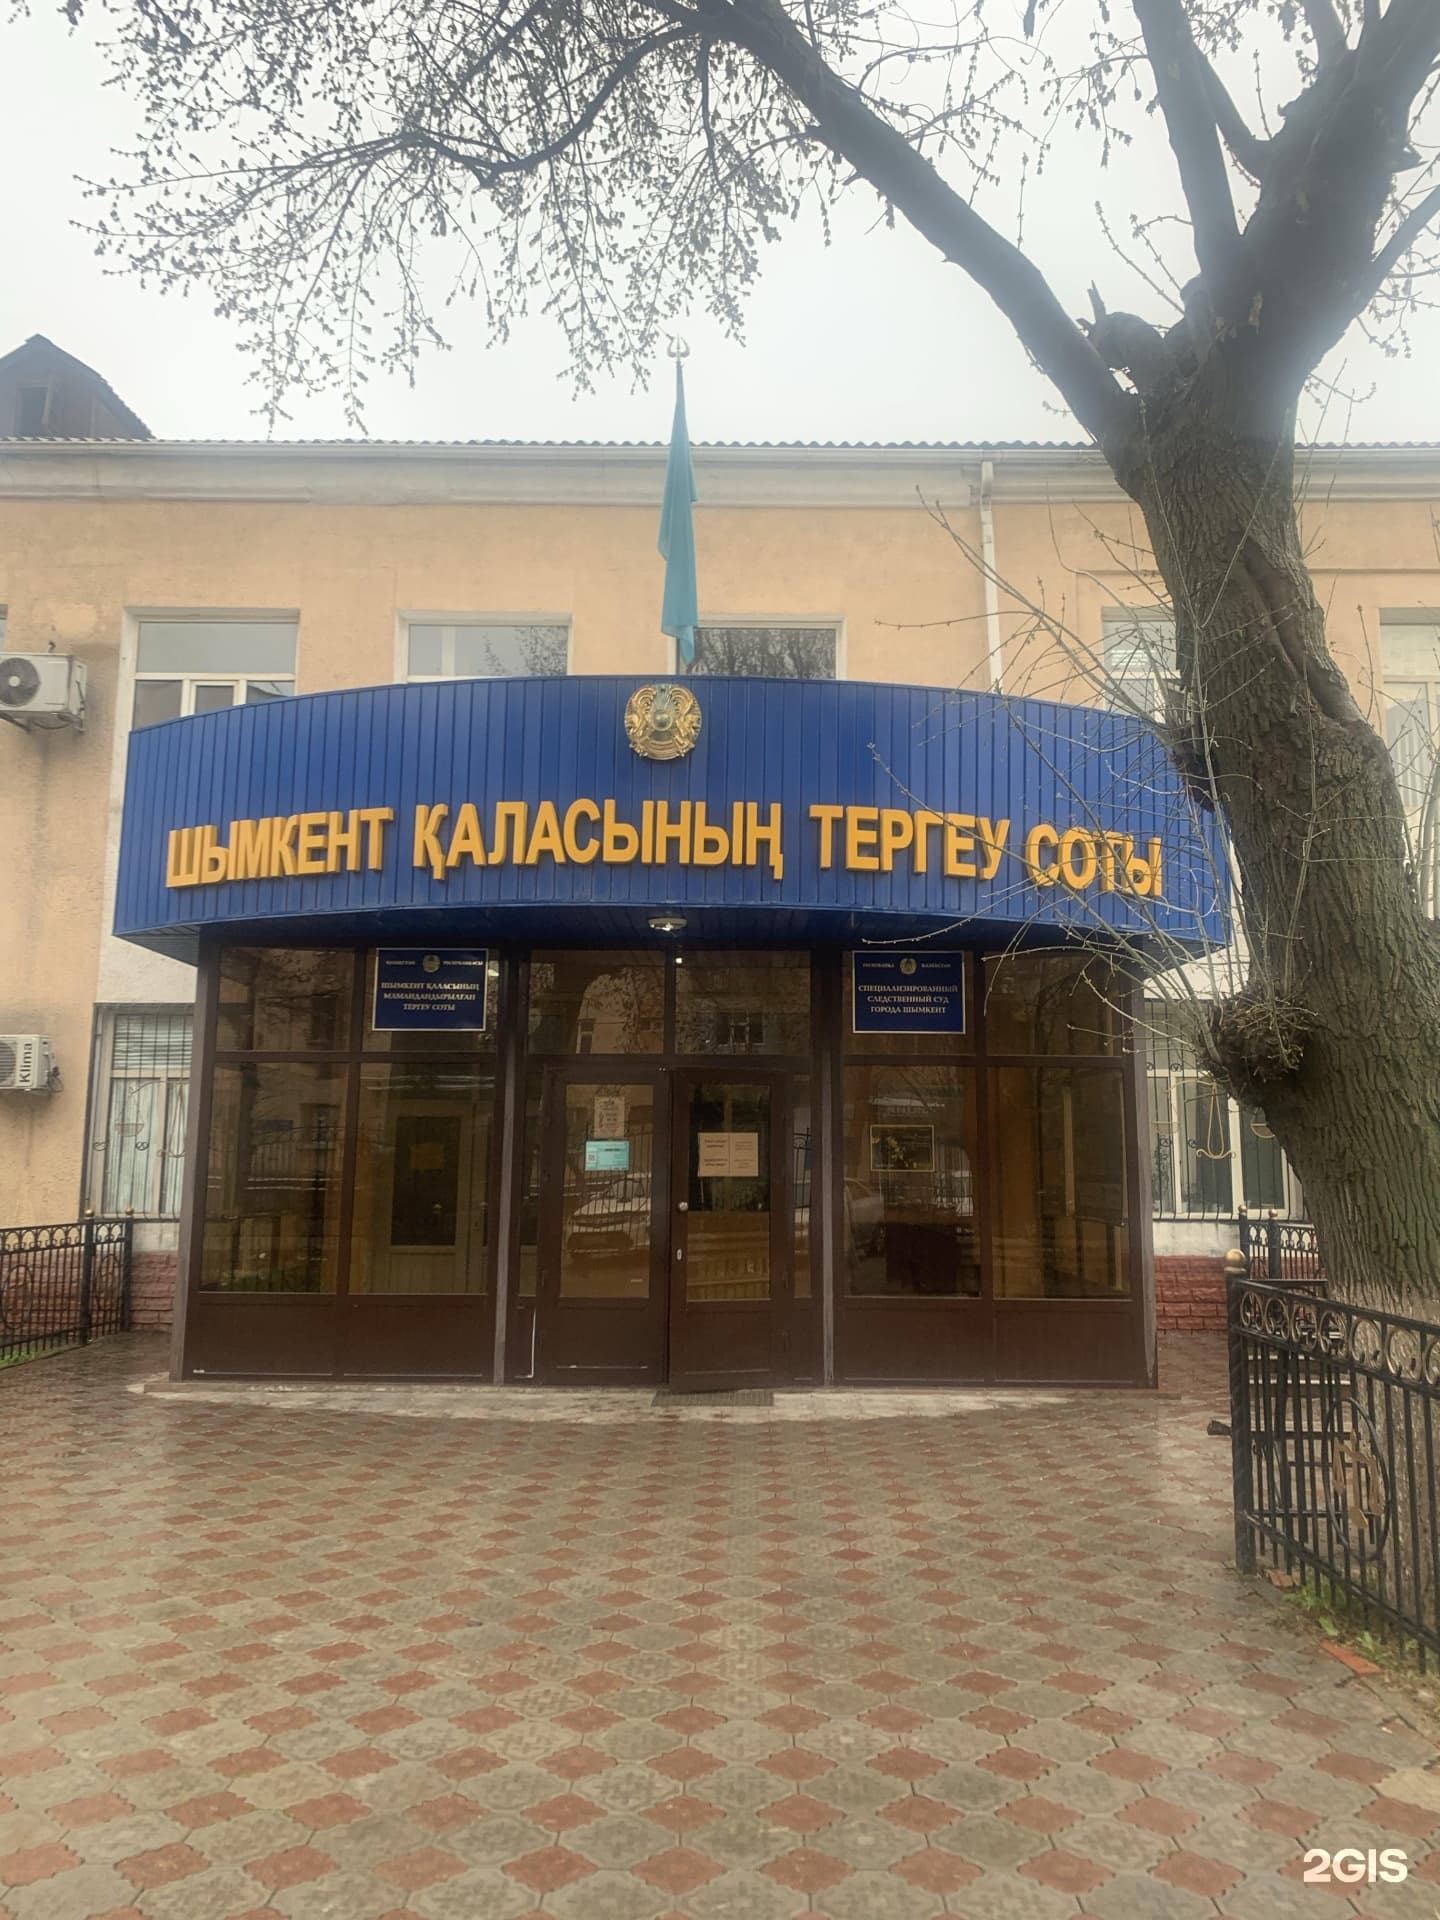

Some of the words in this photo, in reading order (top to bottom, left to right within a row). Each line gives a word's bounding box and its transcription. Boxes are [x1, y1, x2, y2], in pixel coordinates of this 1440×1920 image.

[166, 806, 394, 889] ШЫМКЕНТ
[412, 797, 784, 881] ҚАЛАСЫНЫҢ
[809, 804, 1011, 880] ТЕРГЕУ
[1025, 823, 1164, 897] СОТЫ
[858, 985, 958, 993] СПЕЦИАЛИЗИРОВАННЫЙ
[867, 995, 932, 1003] СЛЕДСТВЕННЫЙ
[933, 996, 950, 1004] СУД
[432, 1003, 456, 1011] СОТЫ
[870, 1006, 902, 1014] ГОРОДА
[903, 1006, 946, 1014] ШЫМКЕНТ
[19, 1043, 32, 1082] Klima
